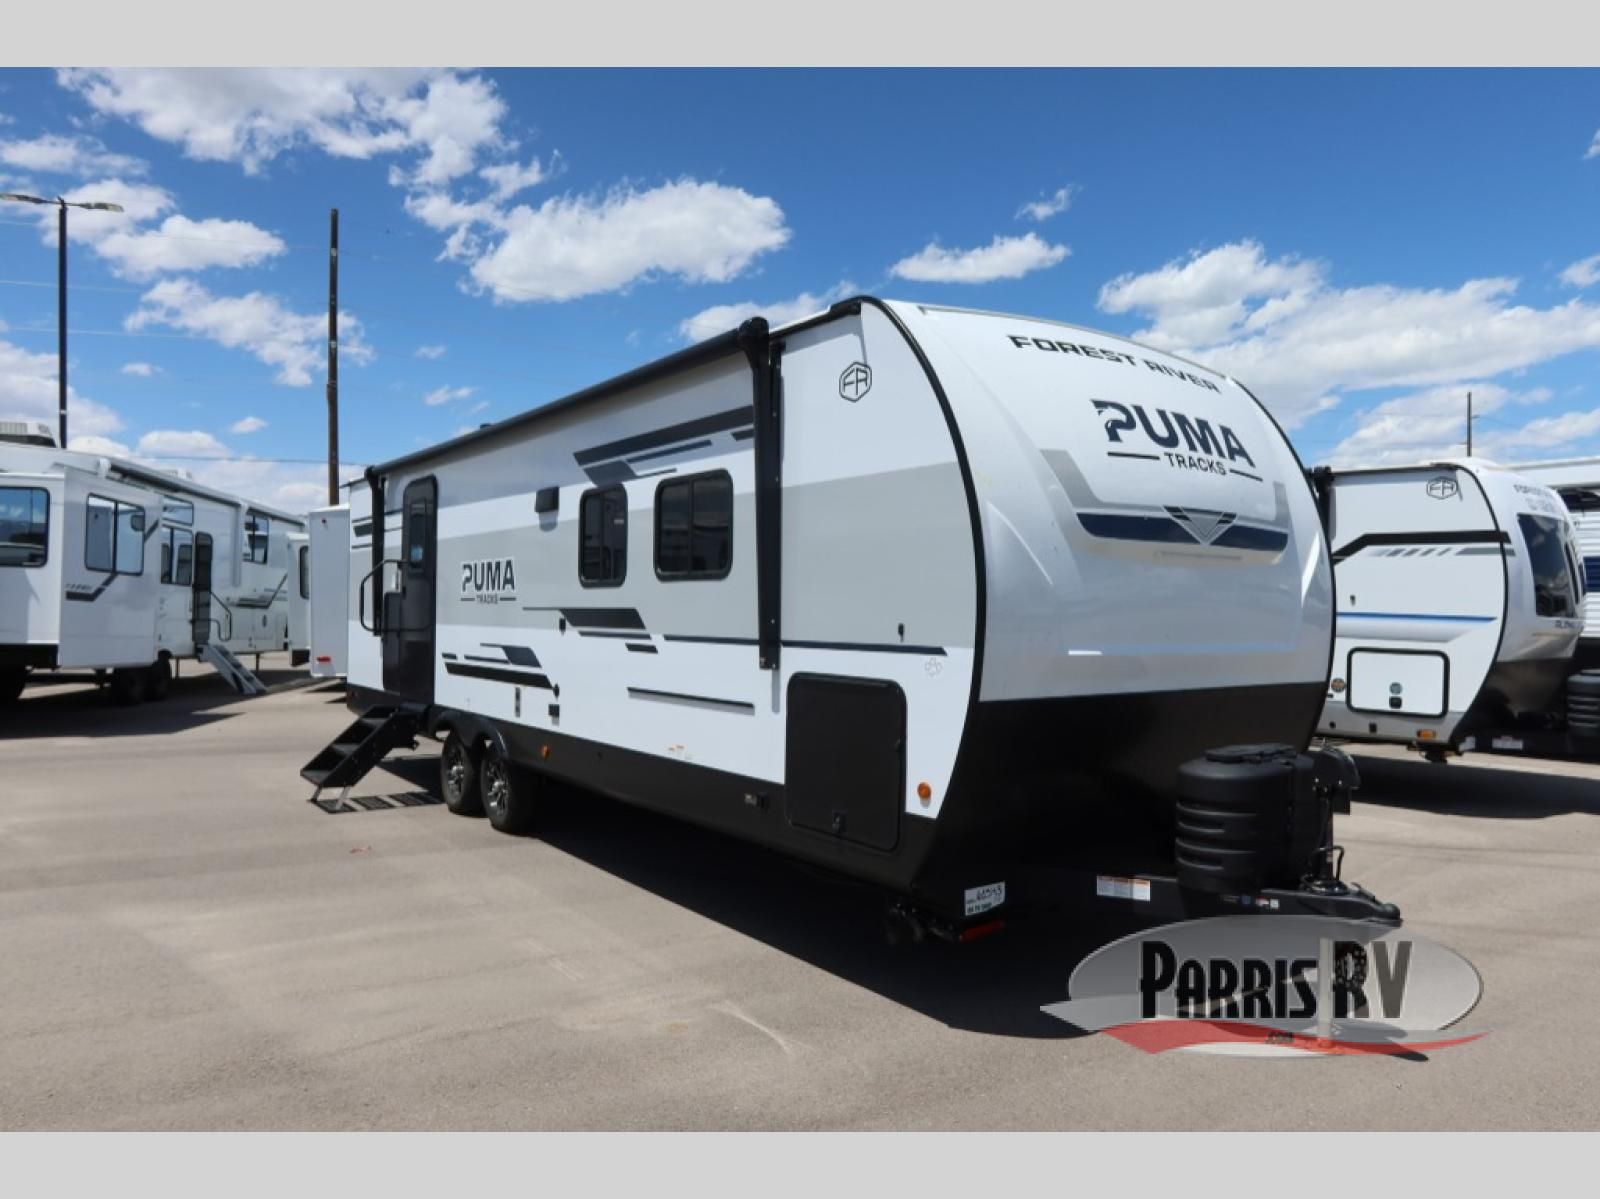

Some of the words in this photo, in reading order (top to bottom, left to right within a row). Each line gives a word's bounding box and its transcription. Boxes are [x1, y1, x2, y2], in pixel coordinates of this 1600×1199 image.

[1008, 335, 1137, 366] FOREST
[1144, 359, 1221, 393] RIVER
[1090, 399, 1256, 468] PUMA
[1163, 452, 1228, 476] TRACKS
[462, 559, 515, 592] PUMA
